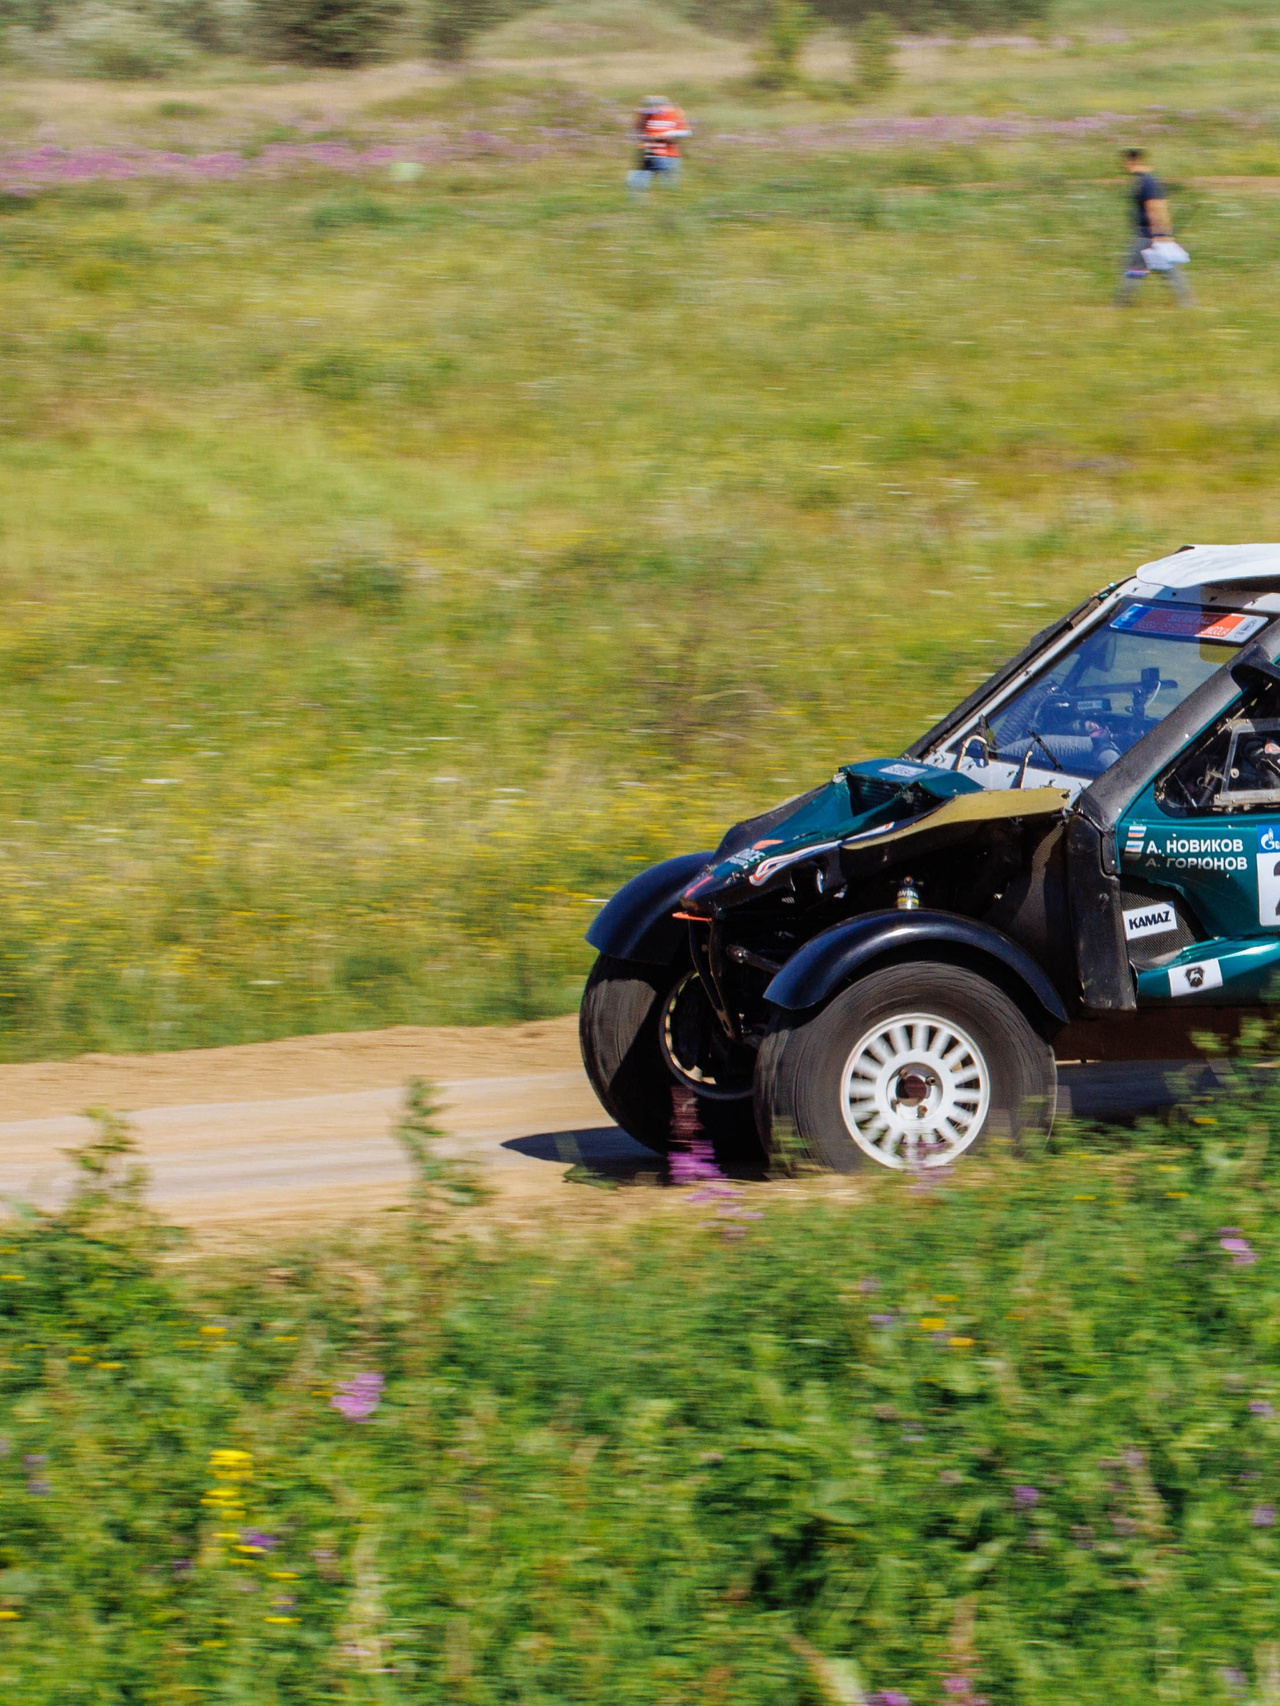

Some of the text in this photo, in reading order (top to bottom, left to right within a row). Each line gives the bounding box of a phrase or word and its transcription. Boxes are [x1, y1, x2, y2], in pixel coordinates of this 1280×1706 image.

[1147, 839, 1244, 854] А. НОВИКОВ
[1146, 857, 1248, 871] А. ГОРЮНОВ
[1128, 911, 1172, 930] KAMAZ
